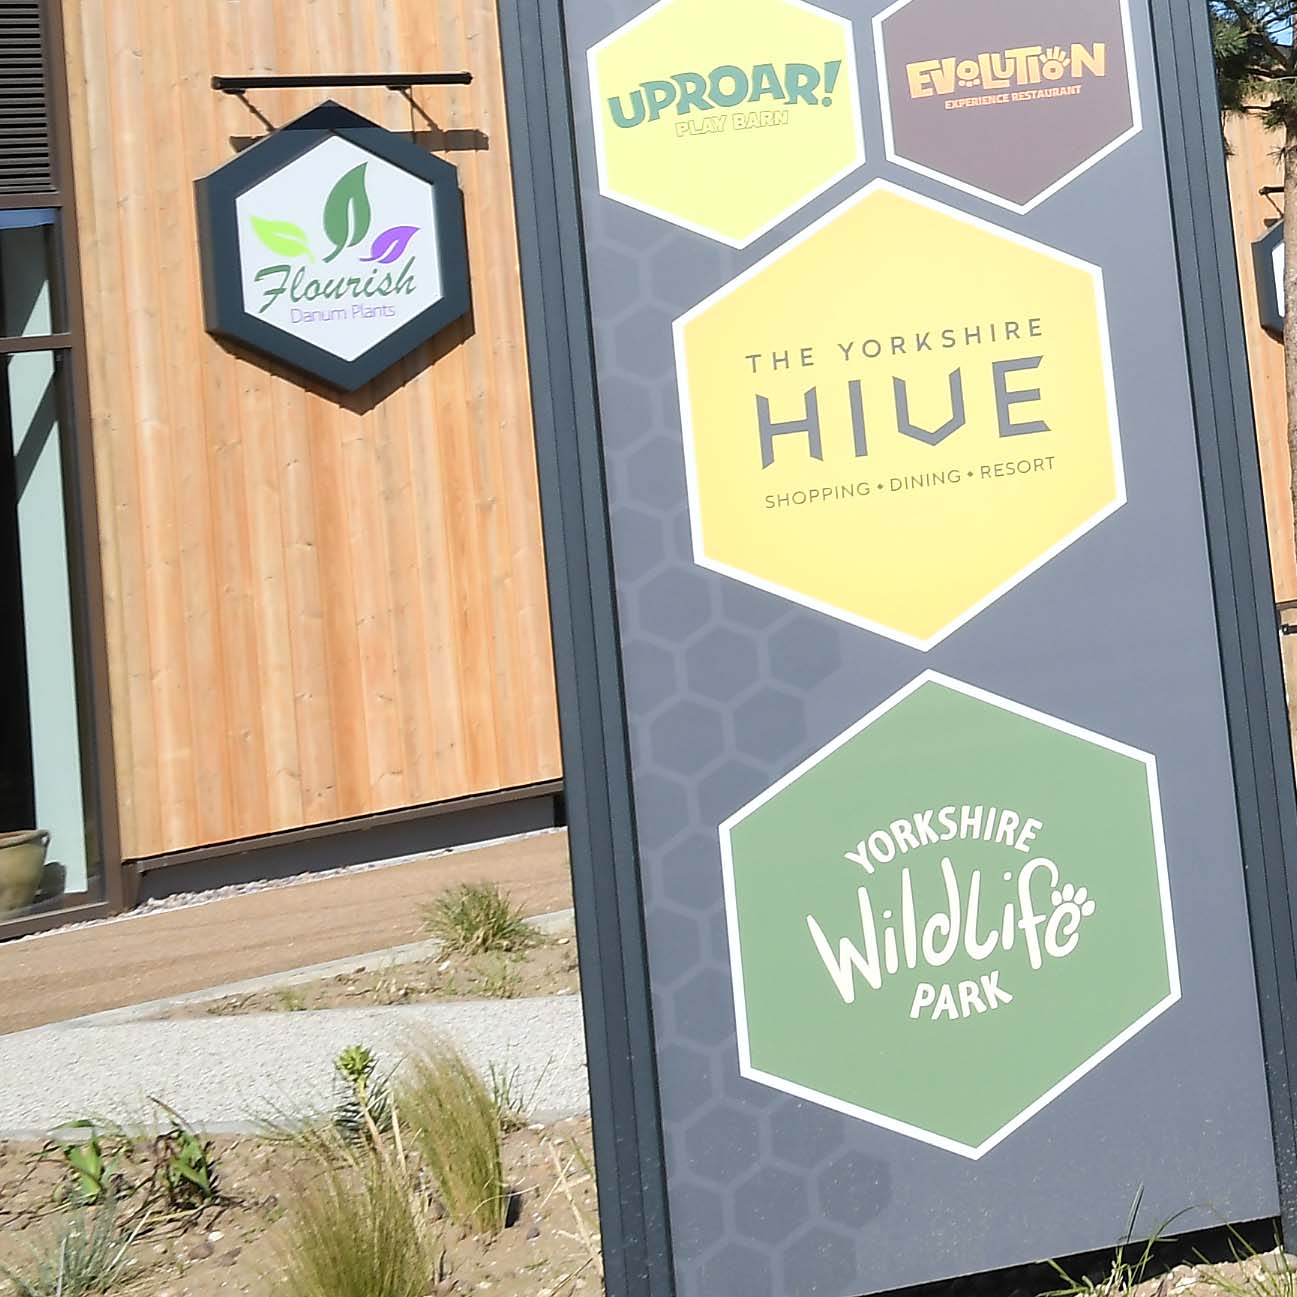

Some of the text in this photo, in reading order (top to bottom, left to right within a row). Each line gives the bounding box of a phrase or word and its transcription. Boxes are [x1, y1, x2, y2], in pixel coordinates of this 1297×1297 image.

[606, 59, 842, 129] UPROAR!
[905, 41, 1106, 100] EVOLUTION
[943, 84, 1082, 111] EXPERIENCE RESTAURANT
[674, 109, 789, 138] PLAY BARN
[254, 256, 417, 314] Flourish
[289, 304, 396, 324] Danum Plants
[745, 317, 1044, 374] THE YORKSHIRE
[755, 354, 1052, 470] HIVE
[764, 455, 1056, 510] SHOPPING DINING RESORT
[843, 804, 1044, 875] YORKSHIRE
[909, 970, 1014, 1021] PARK
